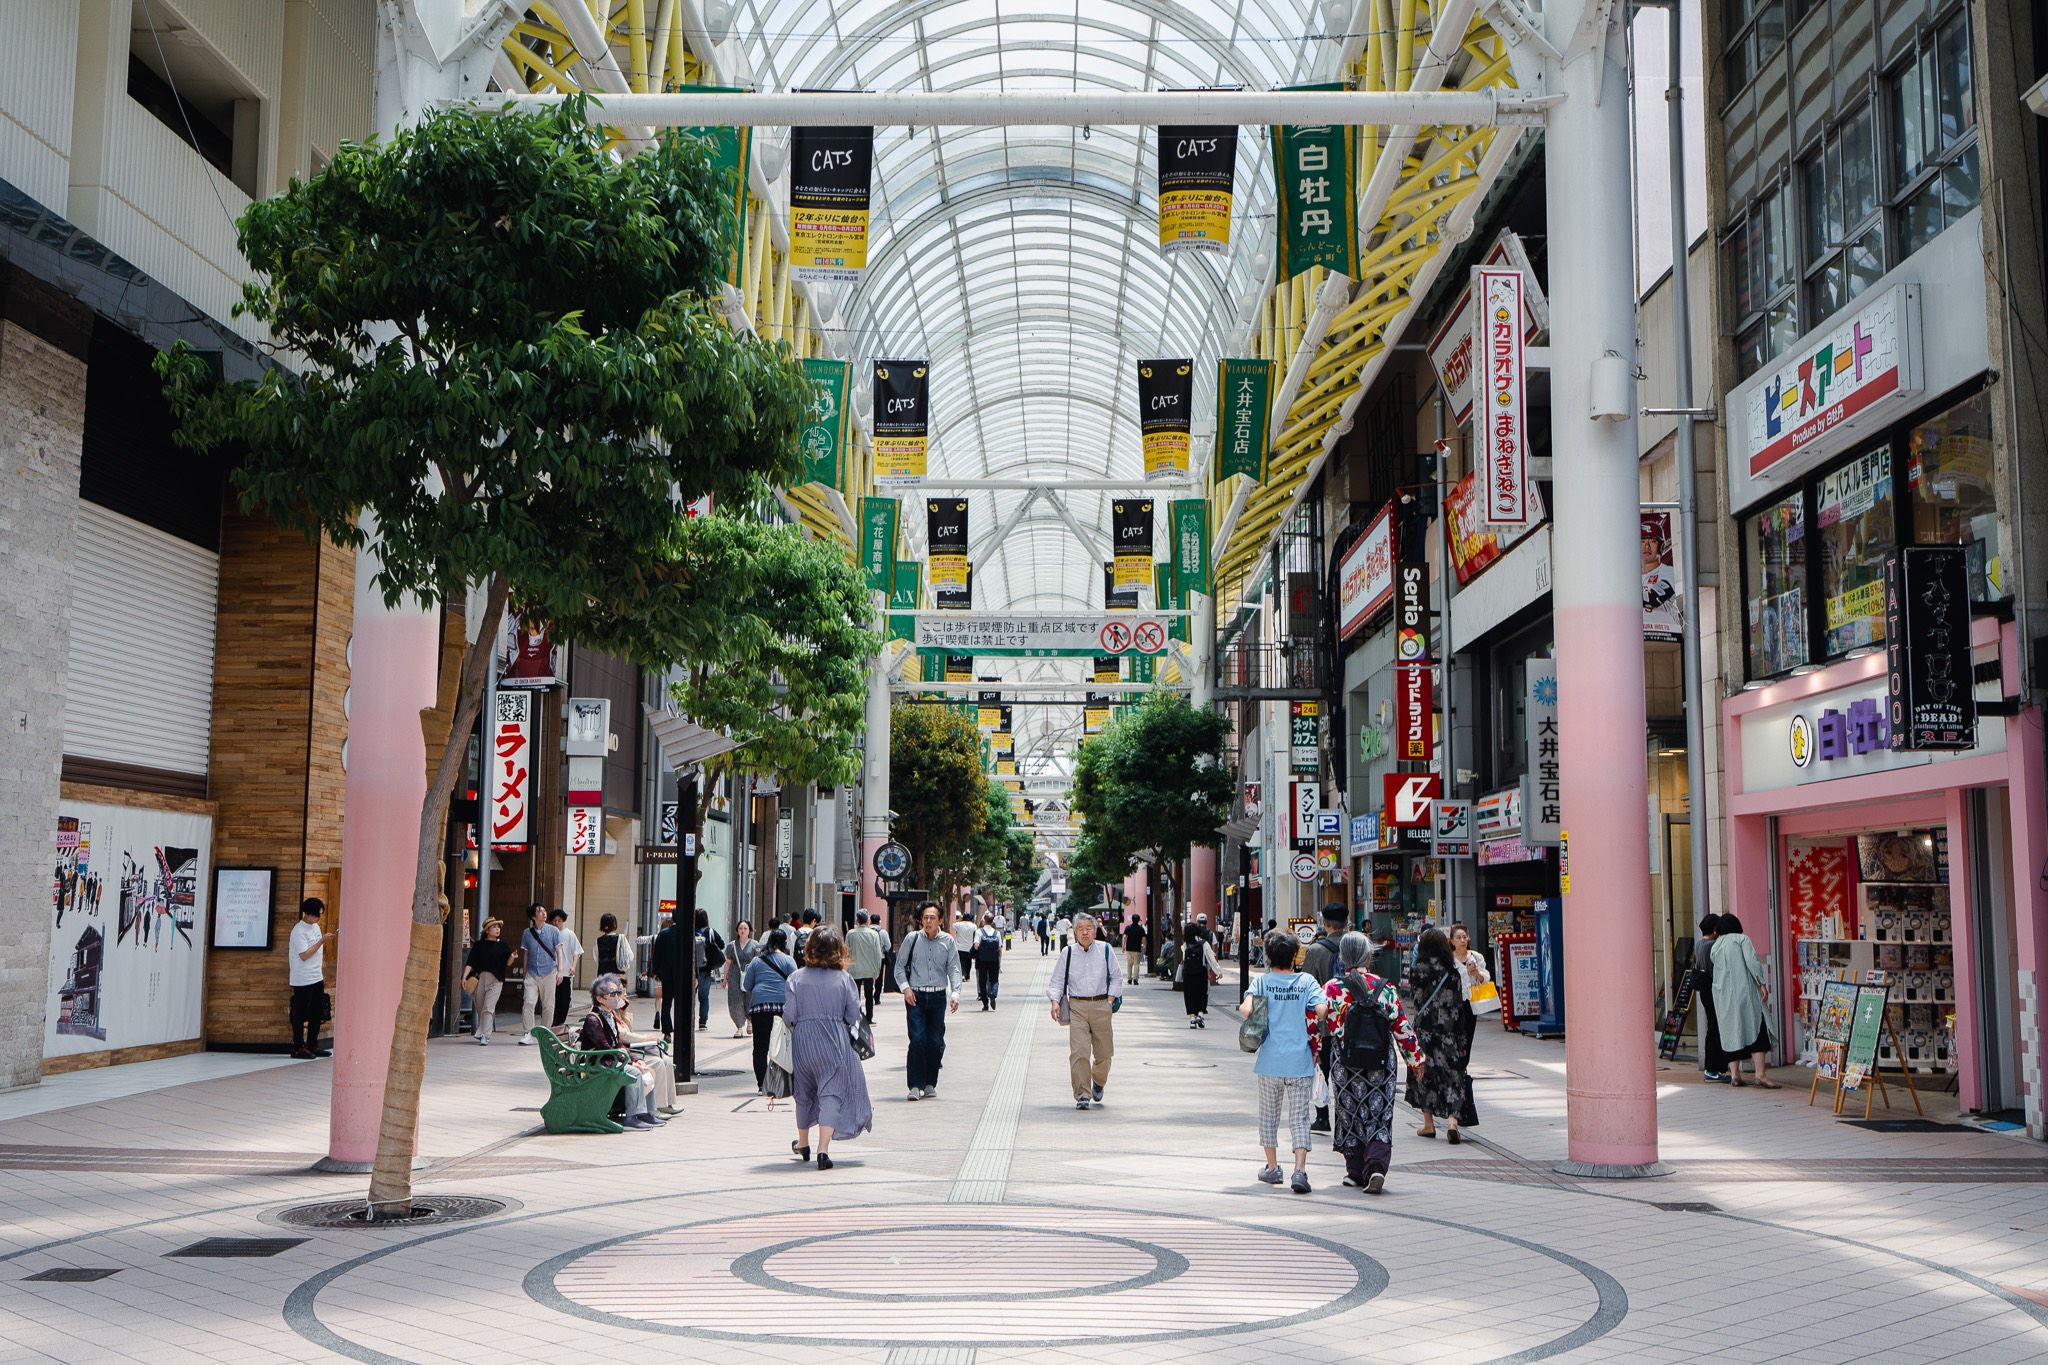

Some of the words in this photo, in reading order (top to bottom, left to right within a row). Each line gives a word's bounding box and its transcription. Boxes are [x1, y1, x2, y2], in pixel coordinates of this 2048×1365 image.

[1177, 139, 1218, 158] CATS
[812, 150, 853, 171] CATS
[1299, 145, 1331, 236] 白牡丹
[1162, 194, 1229, 205] 12年ぶりに仙台へ
[795, 213, 866, 224] 12年ぶりに仙台へ
[795, 232, 865, 240] 東京エレクトロンホール宮城
[1494, 323, 1513, 391] カラオケ
[1765, 321, 1872, 440] ピースアート
[888, 398, 915, 413] CATS
[1152, 395, 1179, 410] CATS
[1233, 378, 1254, 454] 大井宝石店
[1792, 422, 1816, 447] Produce
[1818, 416, 1825, 432] by
[1826, 404, 1844, 426] 白牡丹
[1494, 411, 1518, 516] まねきねこ
[938, 526, 958, 538] CATS
[1122, 527, 1143, 539] CATS
[873, 527, 884, 574] 花屋商事
[1404, 568, 1424, 626] Seria
[922, 622, 1099, 633] ここは歩行喫煙防止重点区域です
[922, 634, 1028, 646] 歩行喫煙は禁止です
[1887, 559, 1903, 724] TATTOO
[1409, 663, 1422, 740] サンドラッグ
[1915, 705, 1930, 718] DAY
[1946, 704, 1962, 714] THE
[1919, 713, 1958, 723] DEAD
[1293, 717, 1317, 731] ネット
[1915, 724, 1939, 734] clothing
[1293, 731, 1317, 745] カフェ
[1892, 734, 1905, 746] 3F
[1920, 731, 1936, 742] 3
[1944, 732, 1958, 742] F
[1538, 716, 1560, 823] 大井宝石店
[493, 724, 528, 840] ラーメン
[1302, 788, 1315, 835] スシロー
[572, 808, 588, 854] ラーメン
[781, 821, 790, 841] cafe
[1319, 815, 1338, 832] P
[1298, 839, 1314, 847] B1F
[1319, 838, 1341, 846] Seria
[1459, 845, 1469, 853] ATM
[781, 843, 790, 859] Cat
[1293, 864, 1316, 872] スシロー
[1375, 861, 1399, 870] Seria
